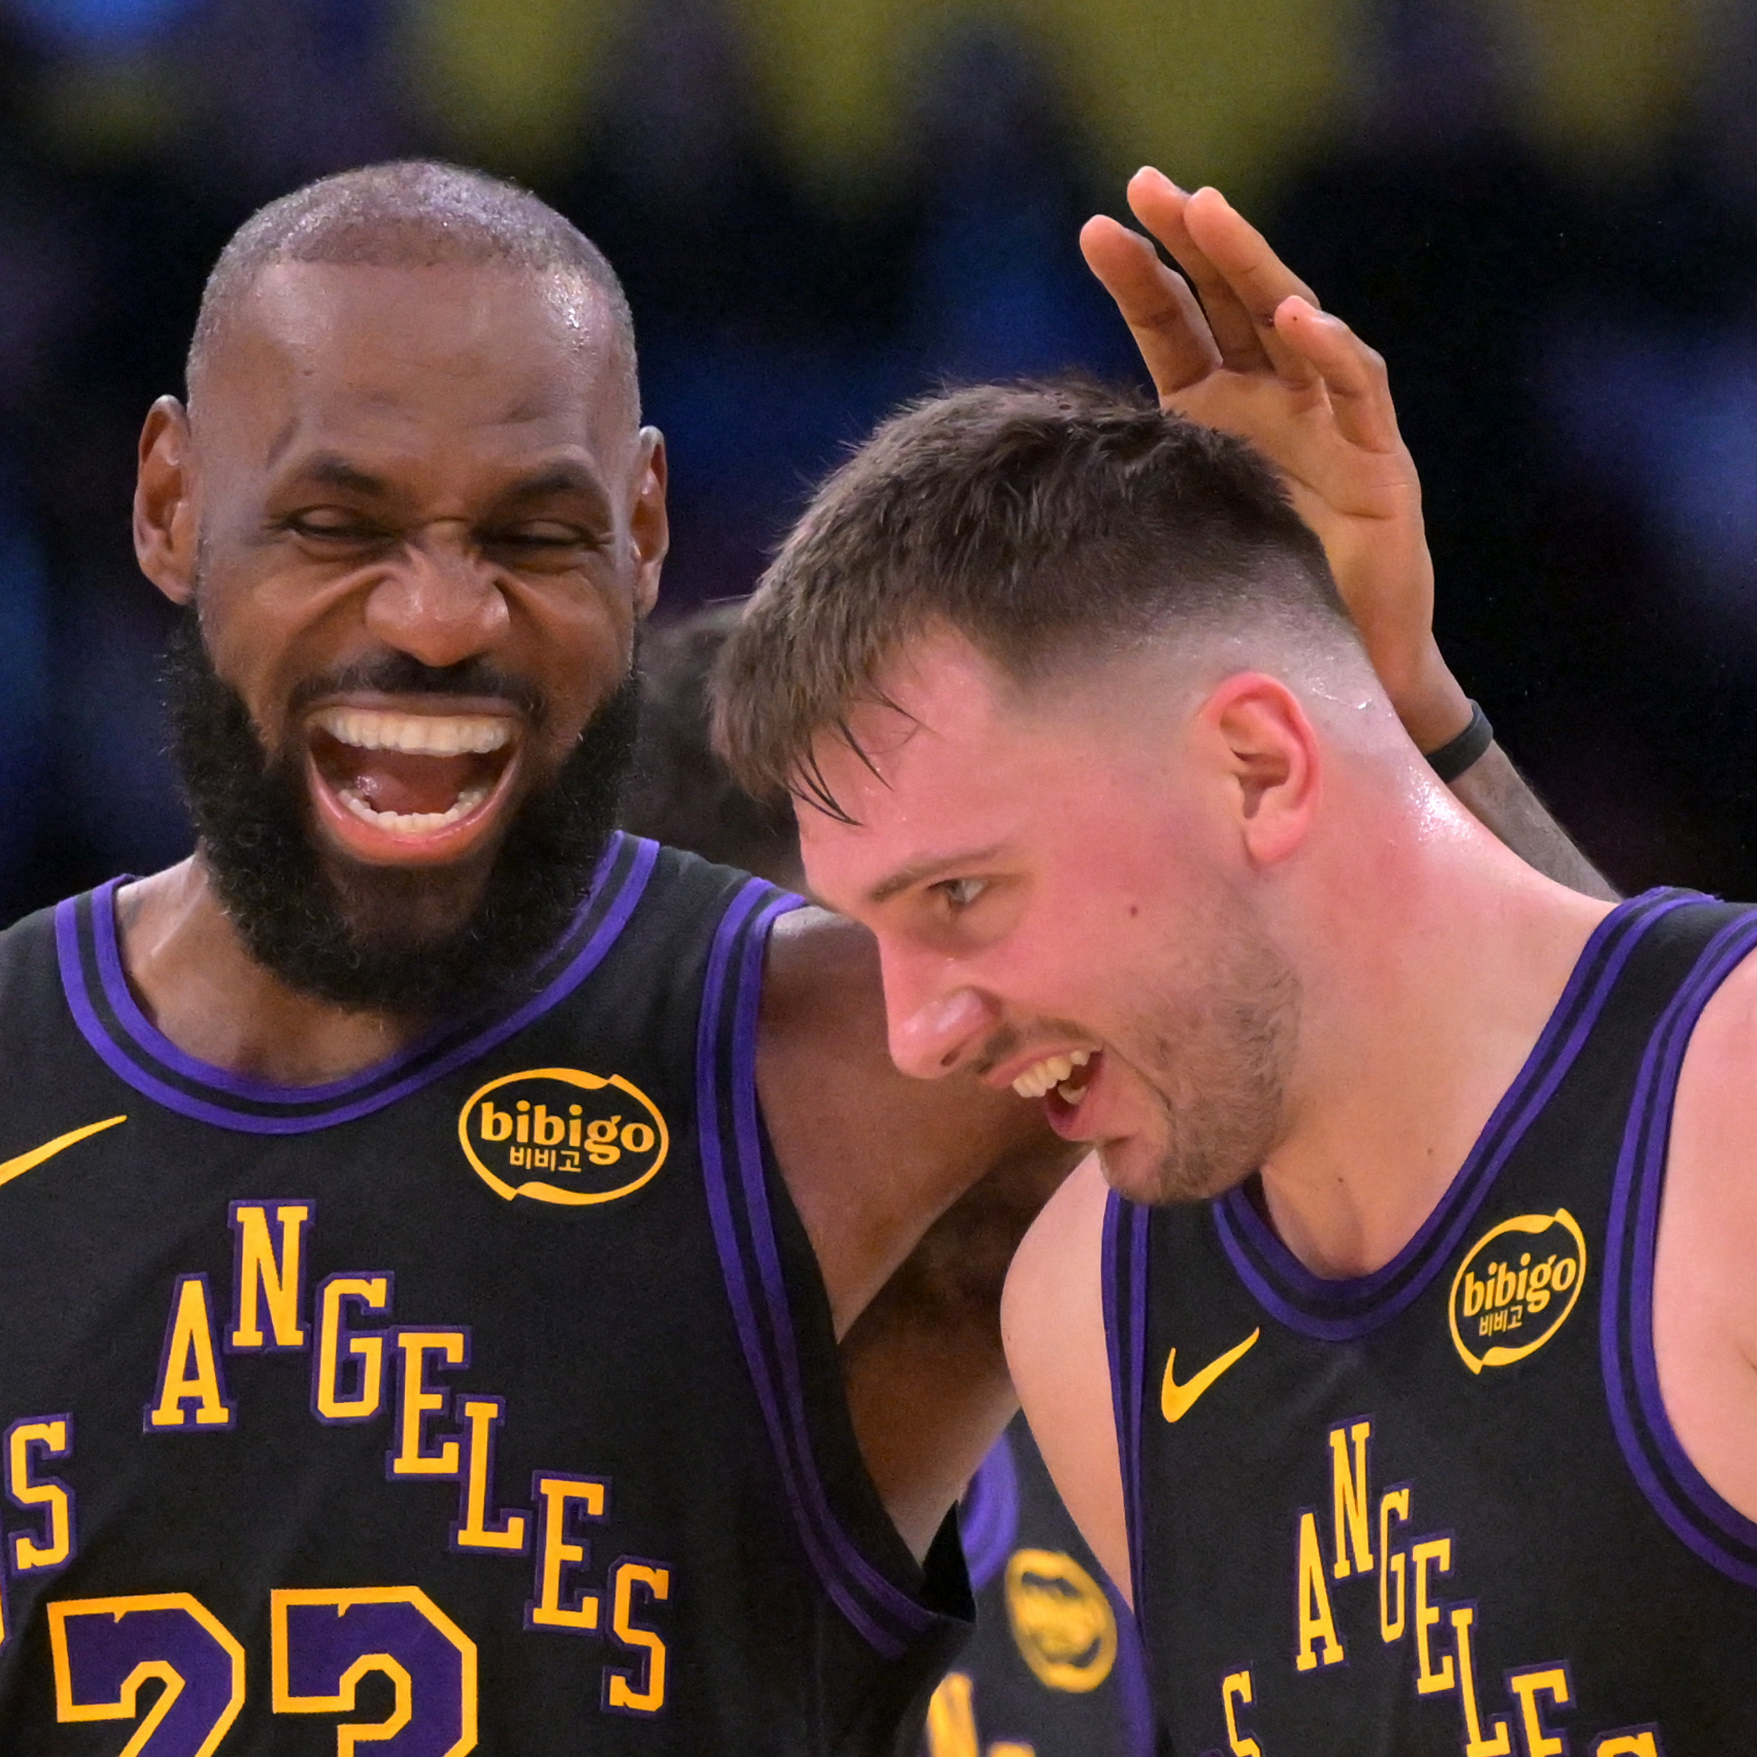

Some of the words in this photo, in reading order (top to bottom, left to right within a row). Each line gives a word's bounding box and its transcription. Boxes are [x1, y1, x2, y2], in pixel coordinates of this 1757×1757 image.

[481, 1100, 655, 1165] bibigo
[510, 1146, 581, 1172] 비비고
[1463, 1252, 1577, 1317] bibigo
[151, 1204, 669, 1712] ANGELES
